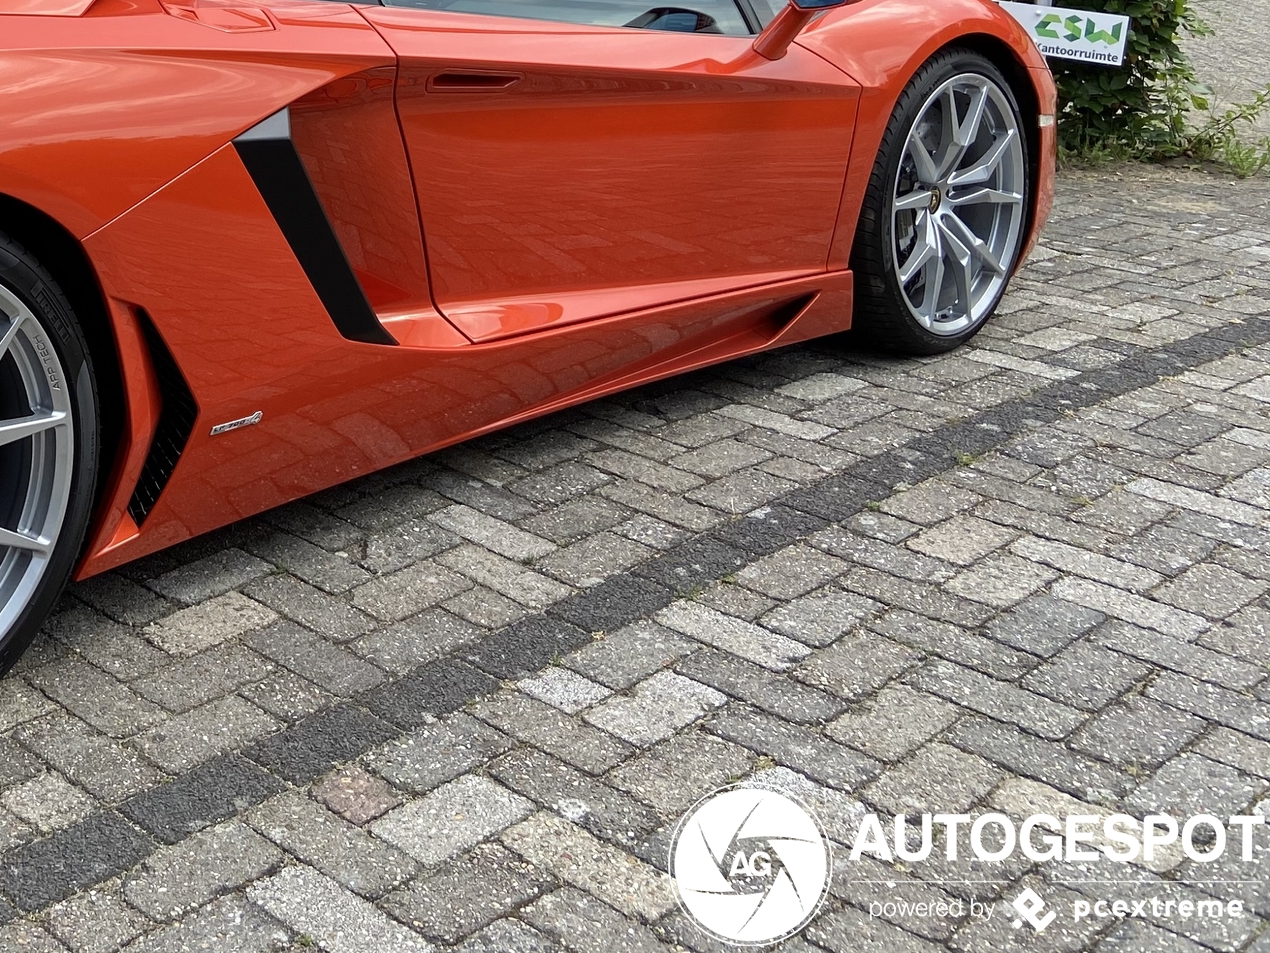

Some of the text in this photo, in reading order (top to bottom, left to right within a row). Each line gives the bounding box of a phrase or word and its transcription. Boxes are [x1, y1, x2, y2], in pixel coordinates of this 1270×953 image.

[1034, 13, 1123, 46] CSW
[30, 279, 75, 346] PIRELLI
[32, 334, 61, 391] APP TECH
